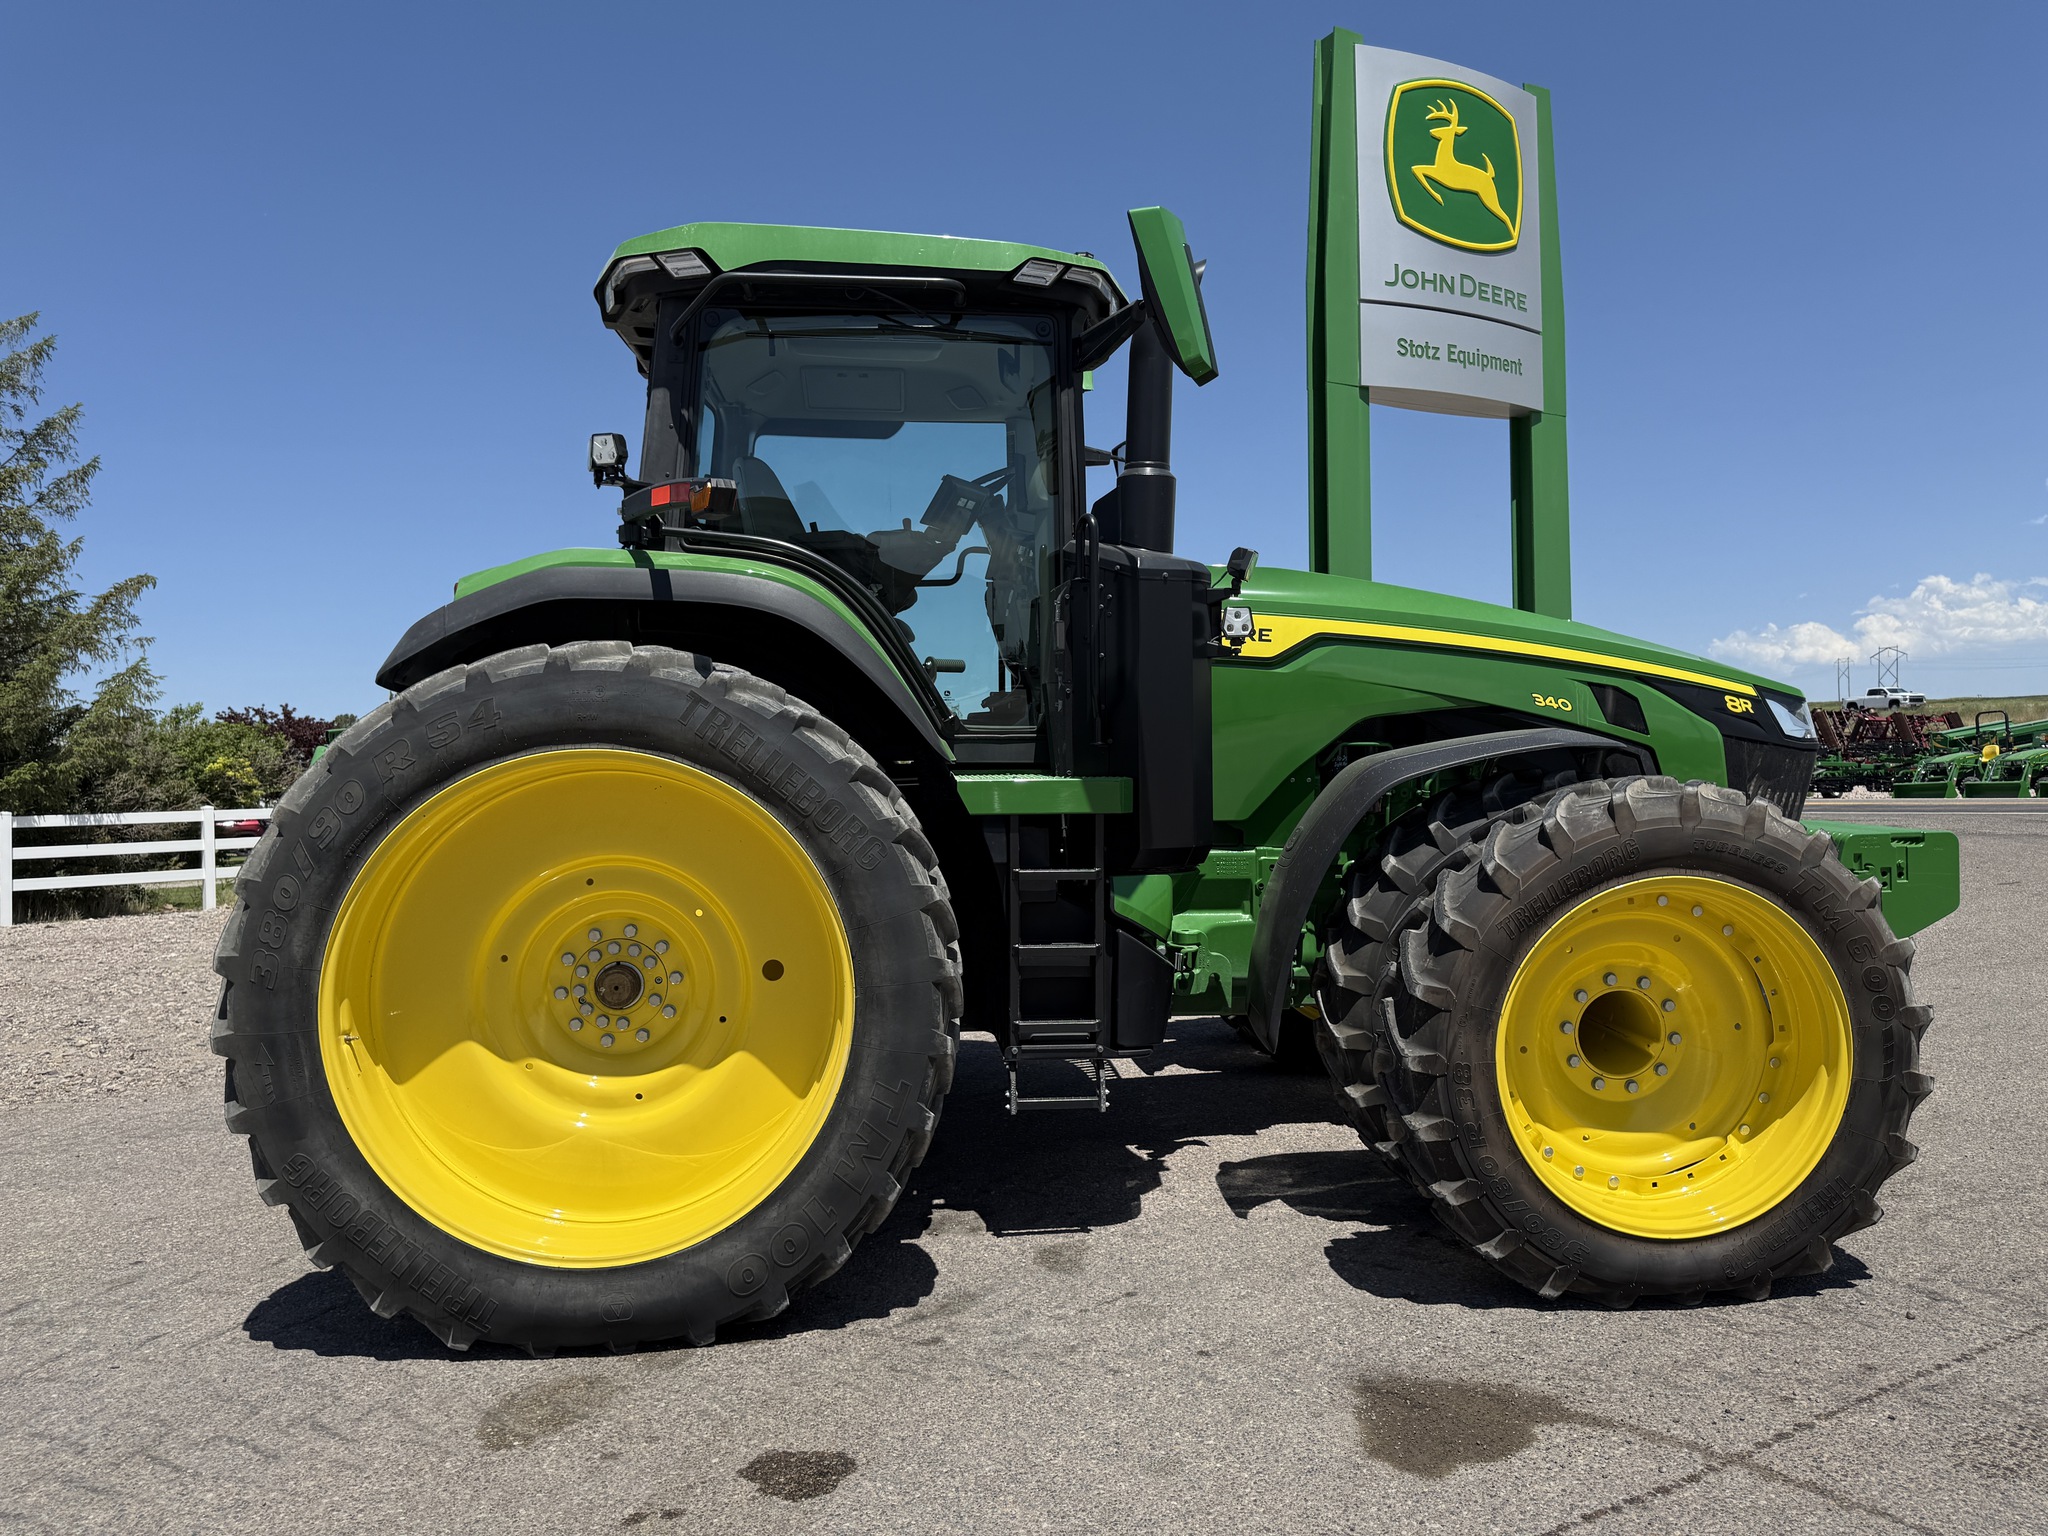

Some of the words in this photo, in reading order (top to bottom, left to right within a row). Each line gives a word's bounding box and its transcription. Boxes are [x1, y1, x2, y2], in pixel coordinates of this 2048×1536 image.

[1384, 263, 1455, 295] JOHN
[1459, 273, 1528, 313] DEERE
[1396, 337, 1441, 361] Stotz
[1447, 343, 1523, 377] Equipment
[1531, 693, 1573, 712] 340
[1724, 694, 1755, 714] 8R
[676, 689, 889, 872] TRELLEBORG
[249, 779, 365, 991] 380/90
[371, 738, 417, 785] R
[424, 697, 502, 750] 54
[1692, 838, 1789, 875] TUBELESS
[1495, 837, 1642, 941] TRELLEBORG
[1453, 1061, 1477, 1112] 38
[1462, 1121, 1488, 1149] R
[1477, 1155, 1591, 1264] 380/80
[1718, 1175, 1858, 1279] TRELLEBORG
[280, 1152, 501, 1334] TRELLEBORG
